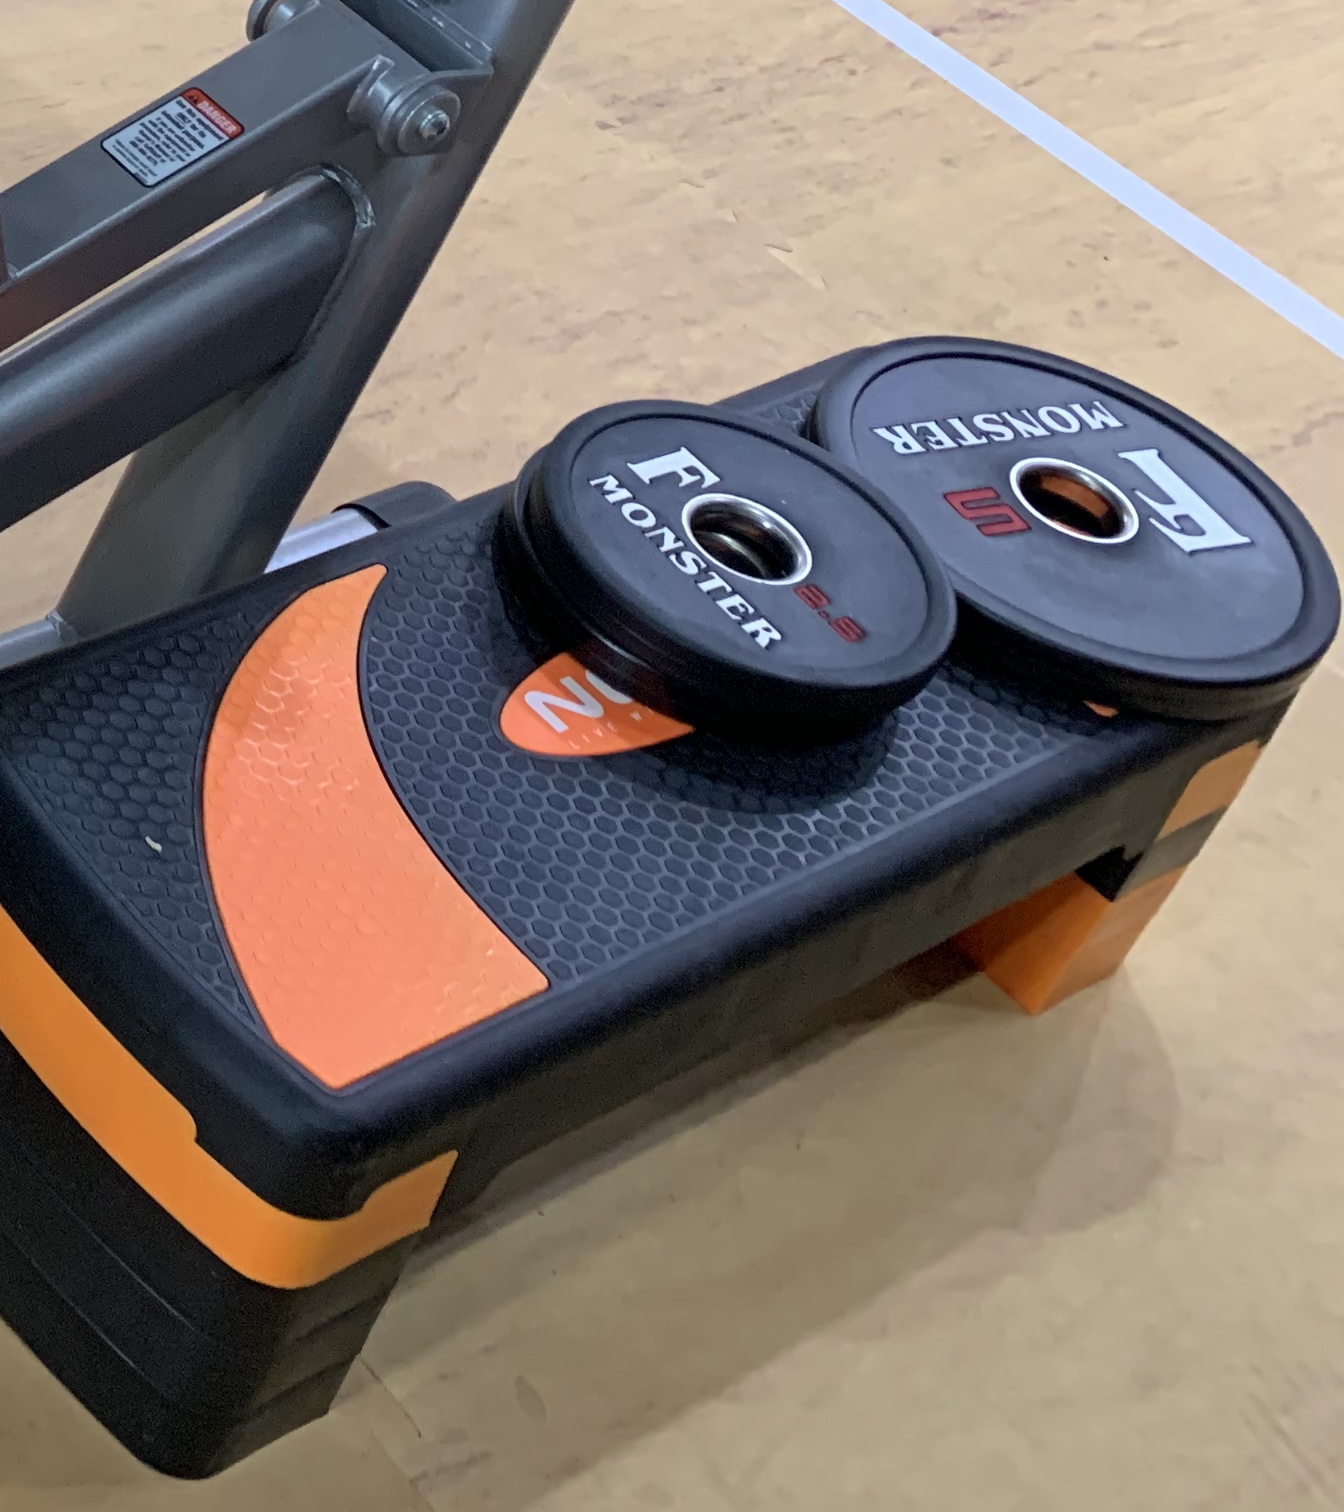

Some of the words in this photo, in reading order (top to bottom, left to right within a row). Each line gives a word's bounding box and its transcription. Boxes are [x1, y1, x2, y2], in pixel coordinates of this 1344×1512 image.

[197, 100, 237, 134] DANGER
[871, 400, 1127, 457] MONSTER
[626, 446, 722, 489] F
[943, 486, 1032, 537] 5
[1117, 448, 1254, 556] F
[588, 474, 782, 650] MONSTER
[793, 583, 867, 643] 2.5
